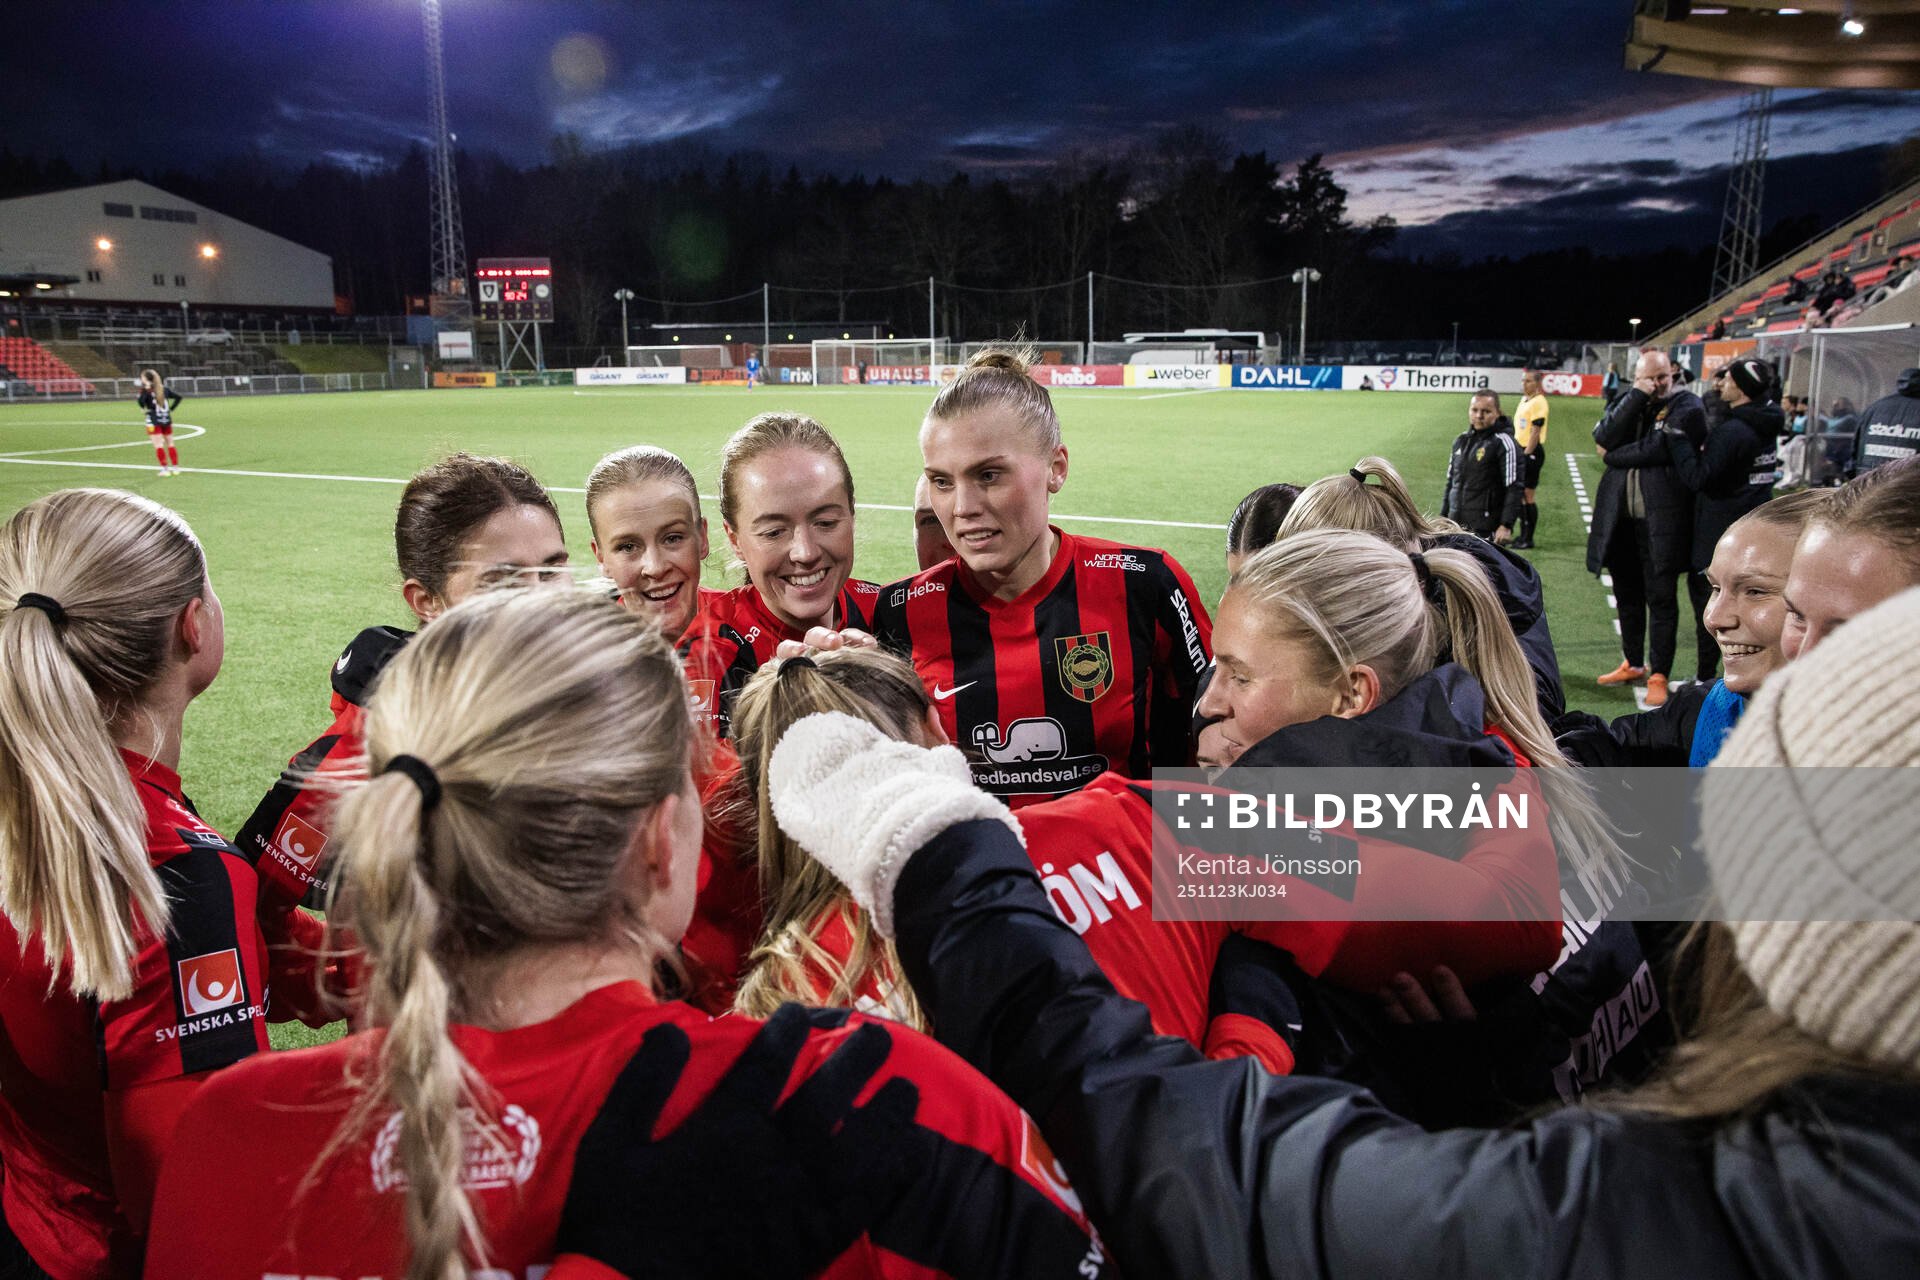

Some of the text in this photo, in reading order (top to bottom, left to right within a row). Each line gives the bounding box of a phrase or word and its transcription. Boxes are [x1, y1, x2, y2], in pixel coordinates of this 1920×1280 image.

[637, 372, 669, 380] GIGANT
[849, 368, 924, 381] BUHAUS
[1051, 366, 1097, 385] habo
[1158, 366, 1211, 380] weber
[1240, 367, 1311, 386] DAHL
[1404, 369, 1489, 389] Thermia
[1083, 560, 1146, 572] WELLNESS
[1094, 553, 1137, 562] NORDIC
[907, 581, 945, 600] Heba
[1170, 588, 1207, 674] stadium
[972, 763, 1102, 785] redbandsval.se
[255, 833, 331, 891] SVENSKA SPEL
[155, 1004, 264, 1042] SVENSKA SPEL
